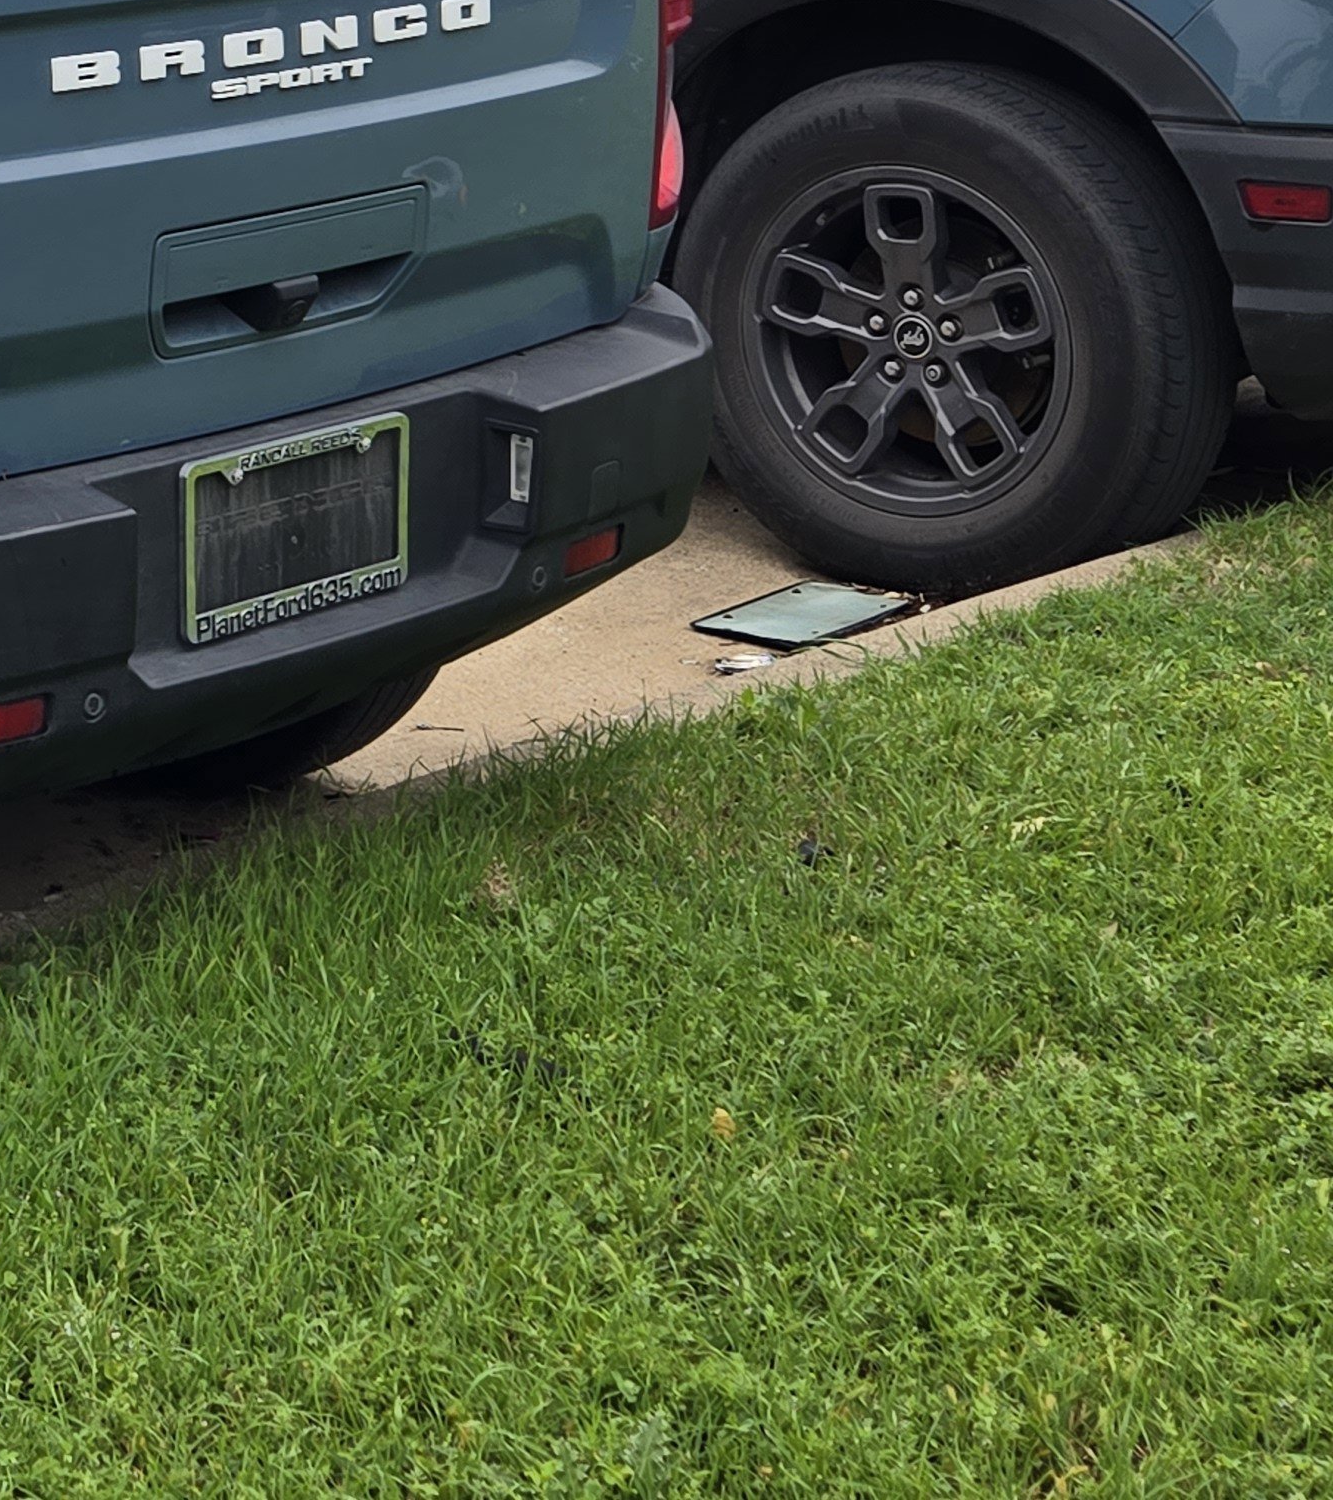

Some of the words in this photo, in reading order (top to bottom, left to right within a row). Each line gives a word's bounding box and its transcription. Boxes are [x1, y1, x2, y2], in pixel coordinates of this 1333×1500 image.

[211, 57, 373, 100] SPORT
[239, 441, 307, 472] RANDALL
[195, 567, 402, 641] PlanetFord635.com
